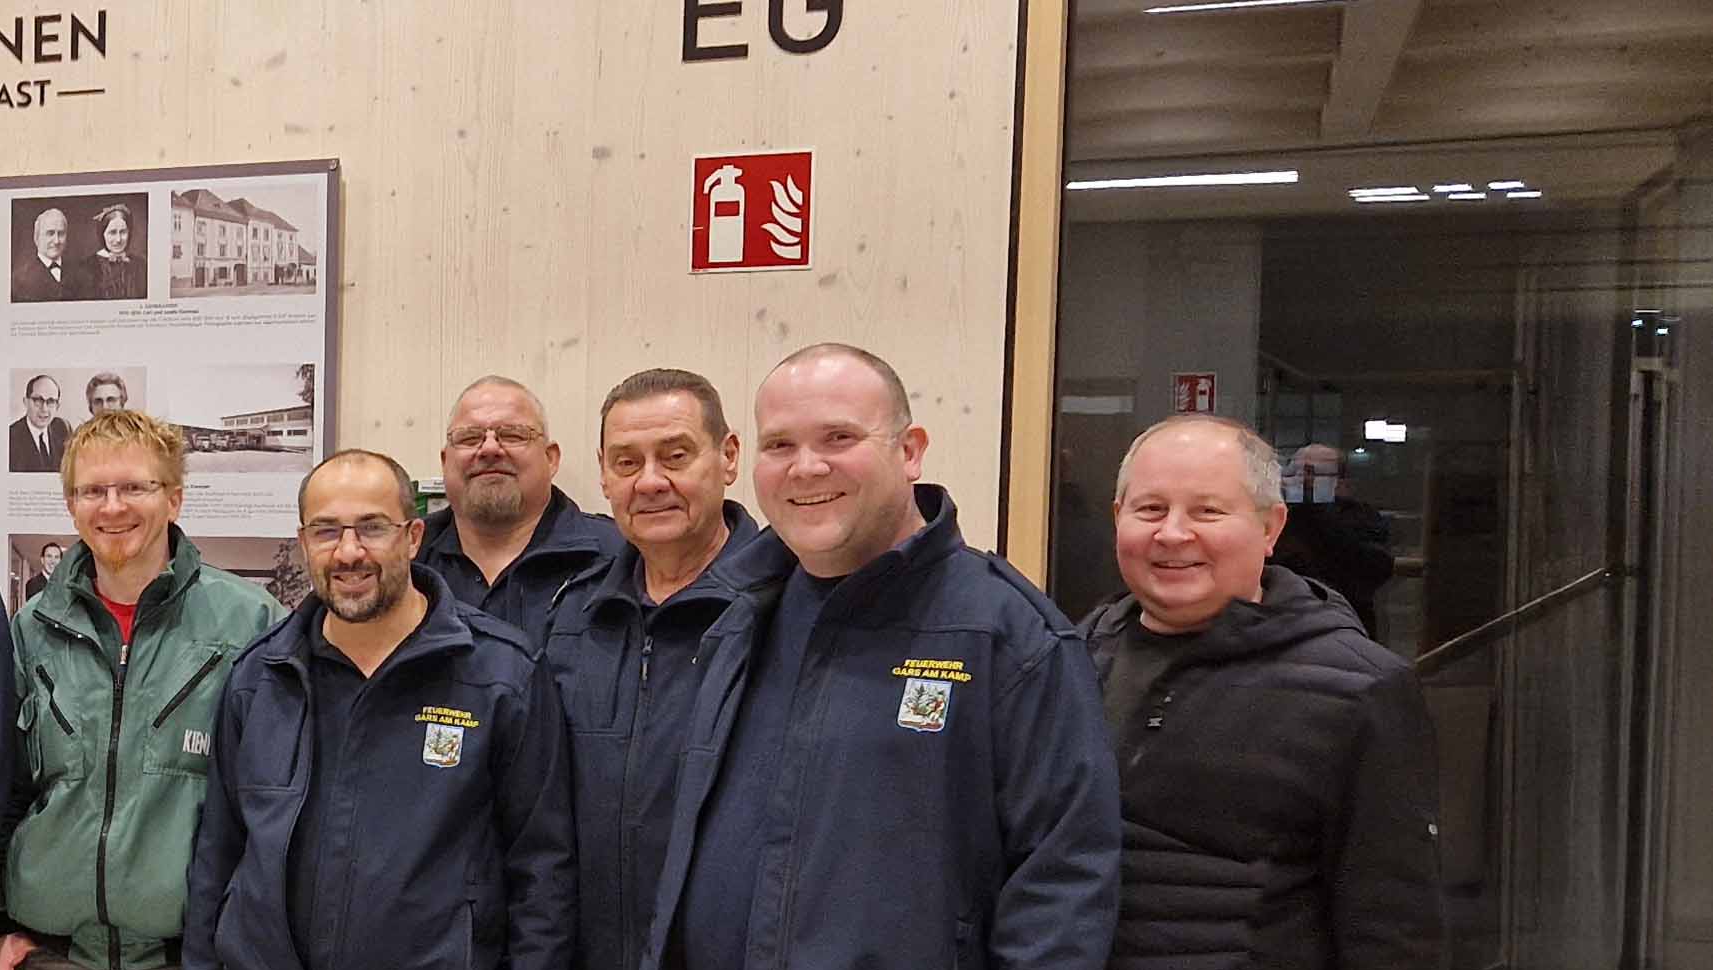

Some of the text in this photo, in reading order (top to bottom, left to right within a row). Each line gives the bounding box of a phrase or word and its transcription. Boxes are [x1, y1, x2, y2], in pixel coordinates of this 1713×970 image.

[681, 0, 844, 63] EG
[903, 659, 964, 670] FEUERWEHR
[892, 667, 972, 682] GARS AM KAMP
